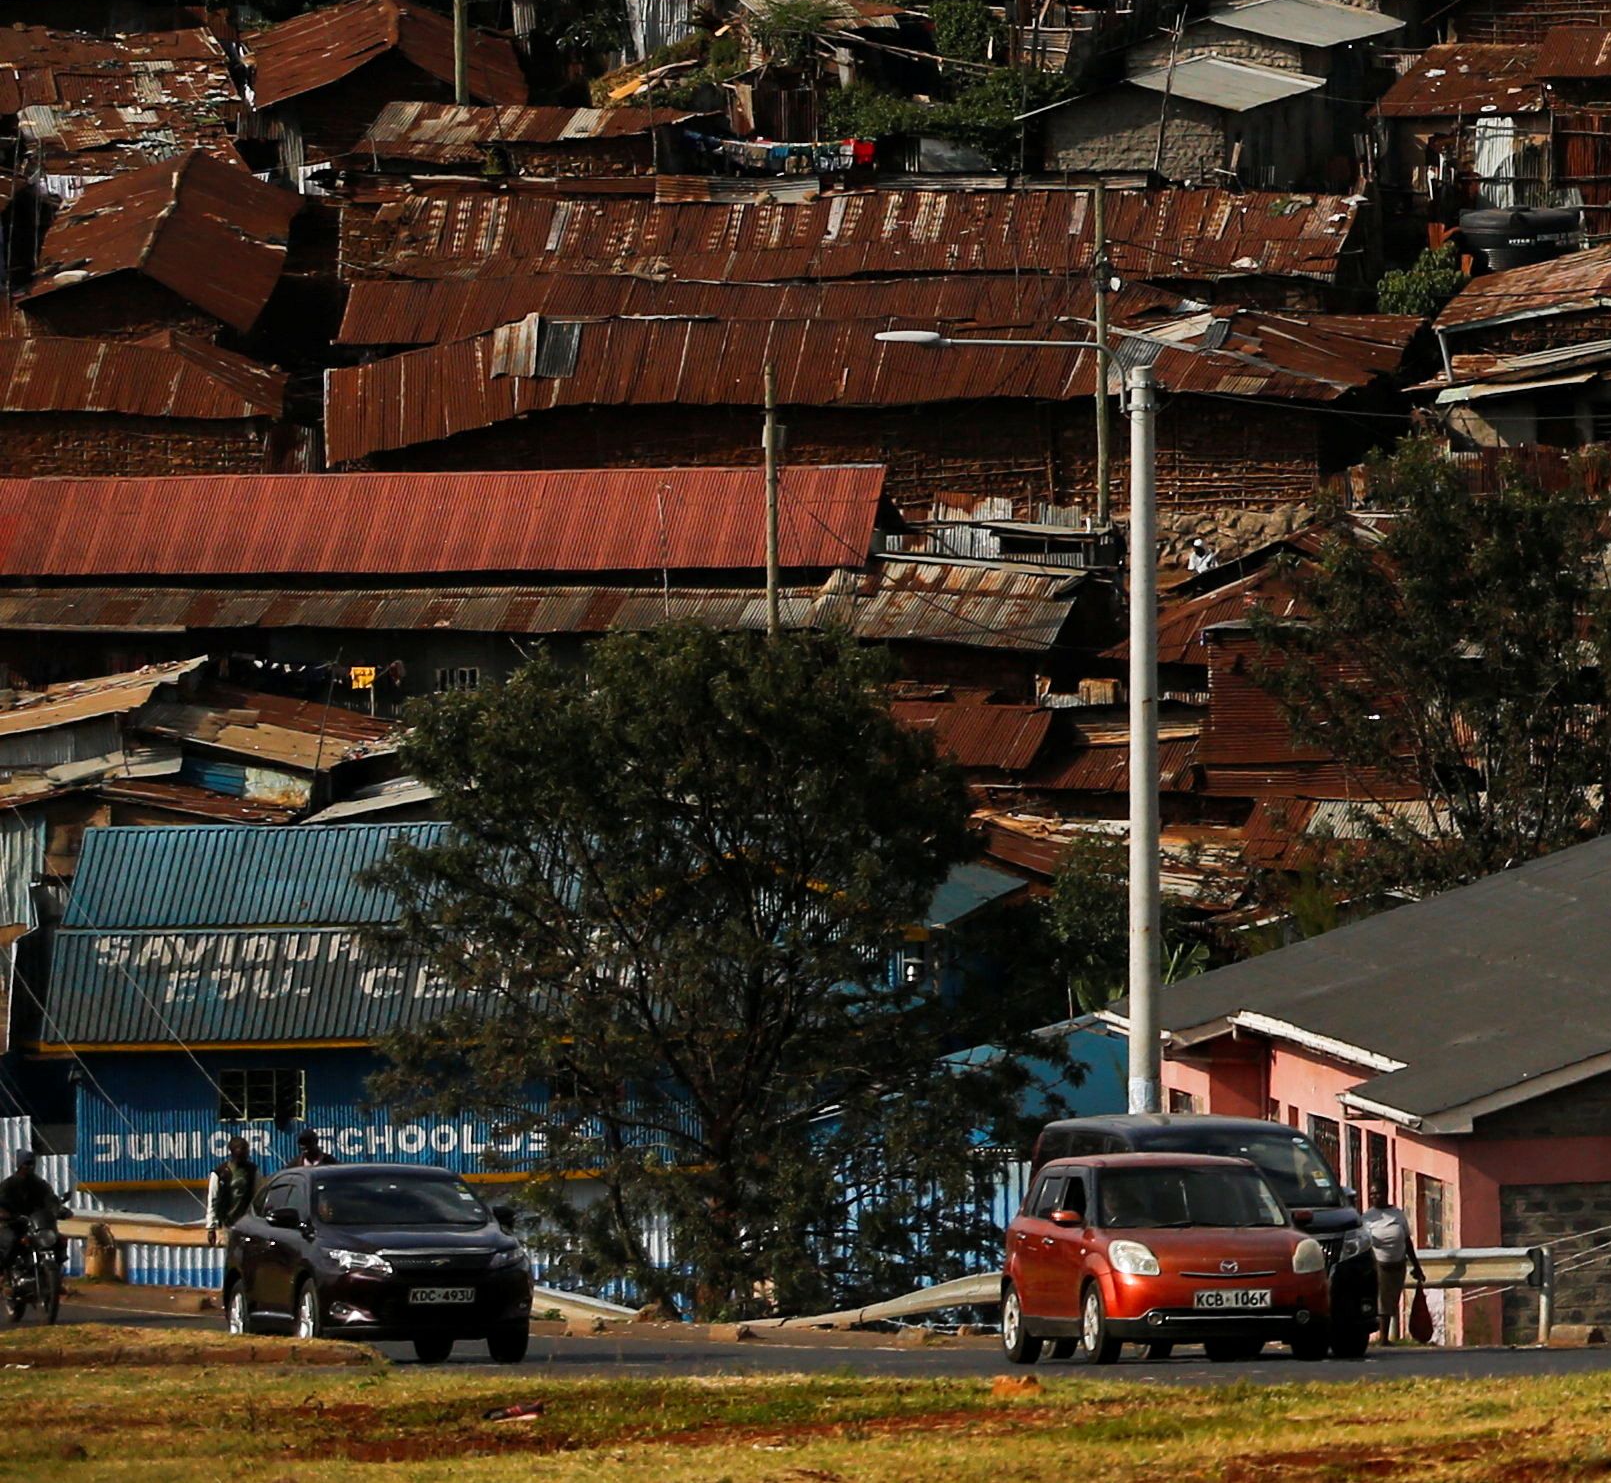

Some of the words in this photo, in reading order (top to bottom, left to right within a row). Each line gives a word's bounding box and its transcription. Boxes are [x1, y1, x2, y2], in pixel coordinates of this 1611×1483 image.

[95, 933, 364, 966] SAVIOUR
[94, 1128, 272, 1162] JUNIOR
[411, 1289, 436, 1301] KDC
[442, 1289, 474, 1301] 493U
[1196, 1293, 1224, 1307] KCB
[1234, 1291, 1268, 1306] 106K
